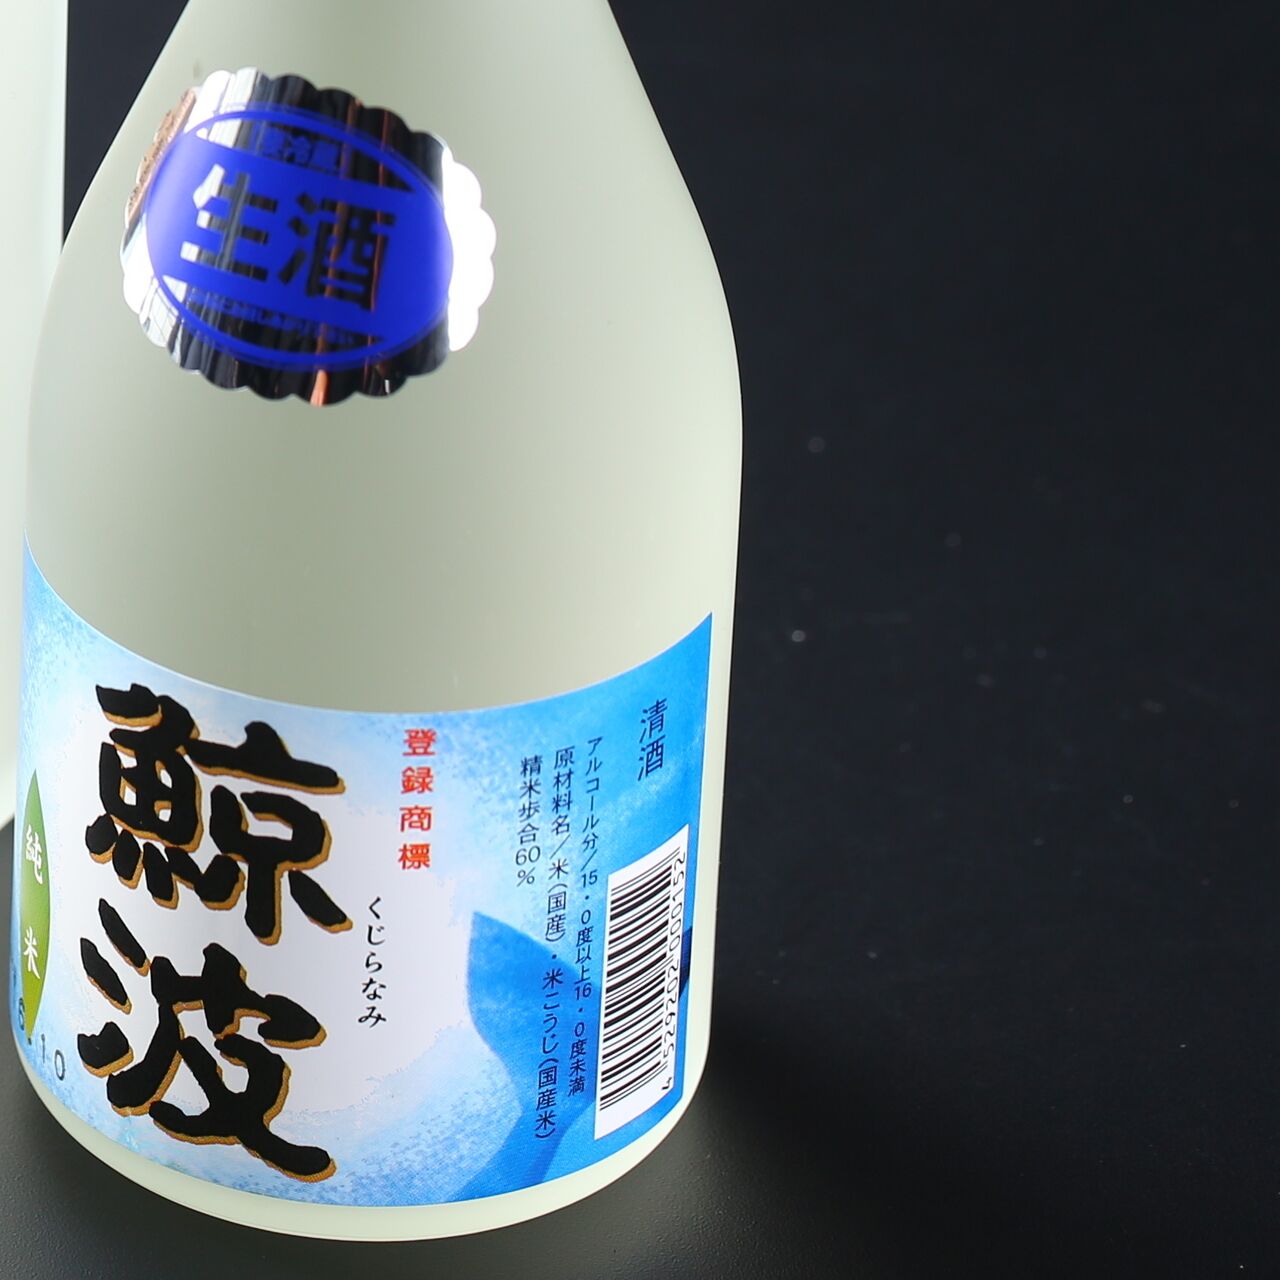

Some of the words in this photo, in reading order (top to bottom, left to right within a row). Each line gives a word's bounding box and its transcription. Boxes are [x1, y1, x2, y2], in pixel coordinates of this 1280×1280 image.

[180, 164, 398, 312] 生酒
[397, 729, 437, 871] 登録商標
[638, 698, 667, 781] 清酒
[515, 753, 544, 887] 精米歩合60%
[23, 824, 44, 980] 純米
[77, 683, 354, 1184] 鯨波
[357, 896, 388, 1029] くじらなみ
